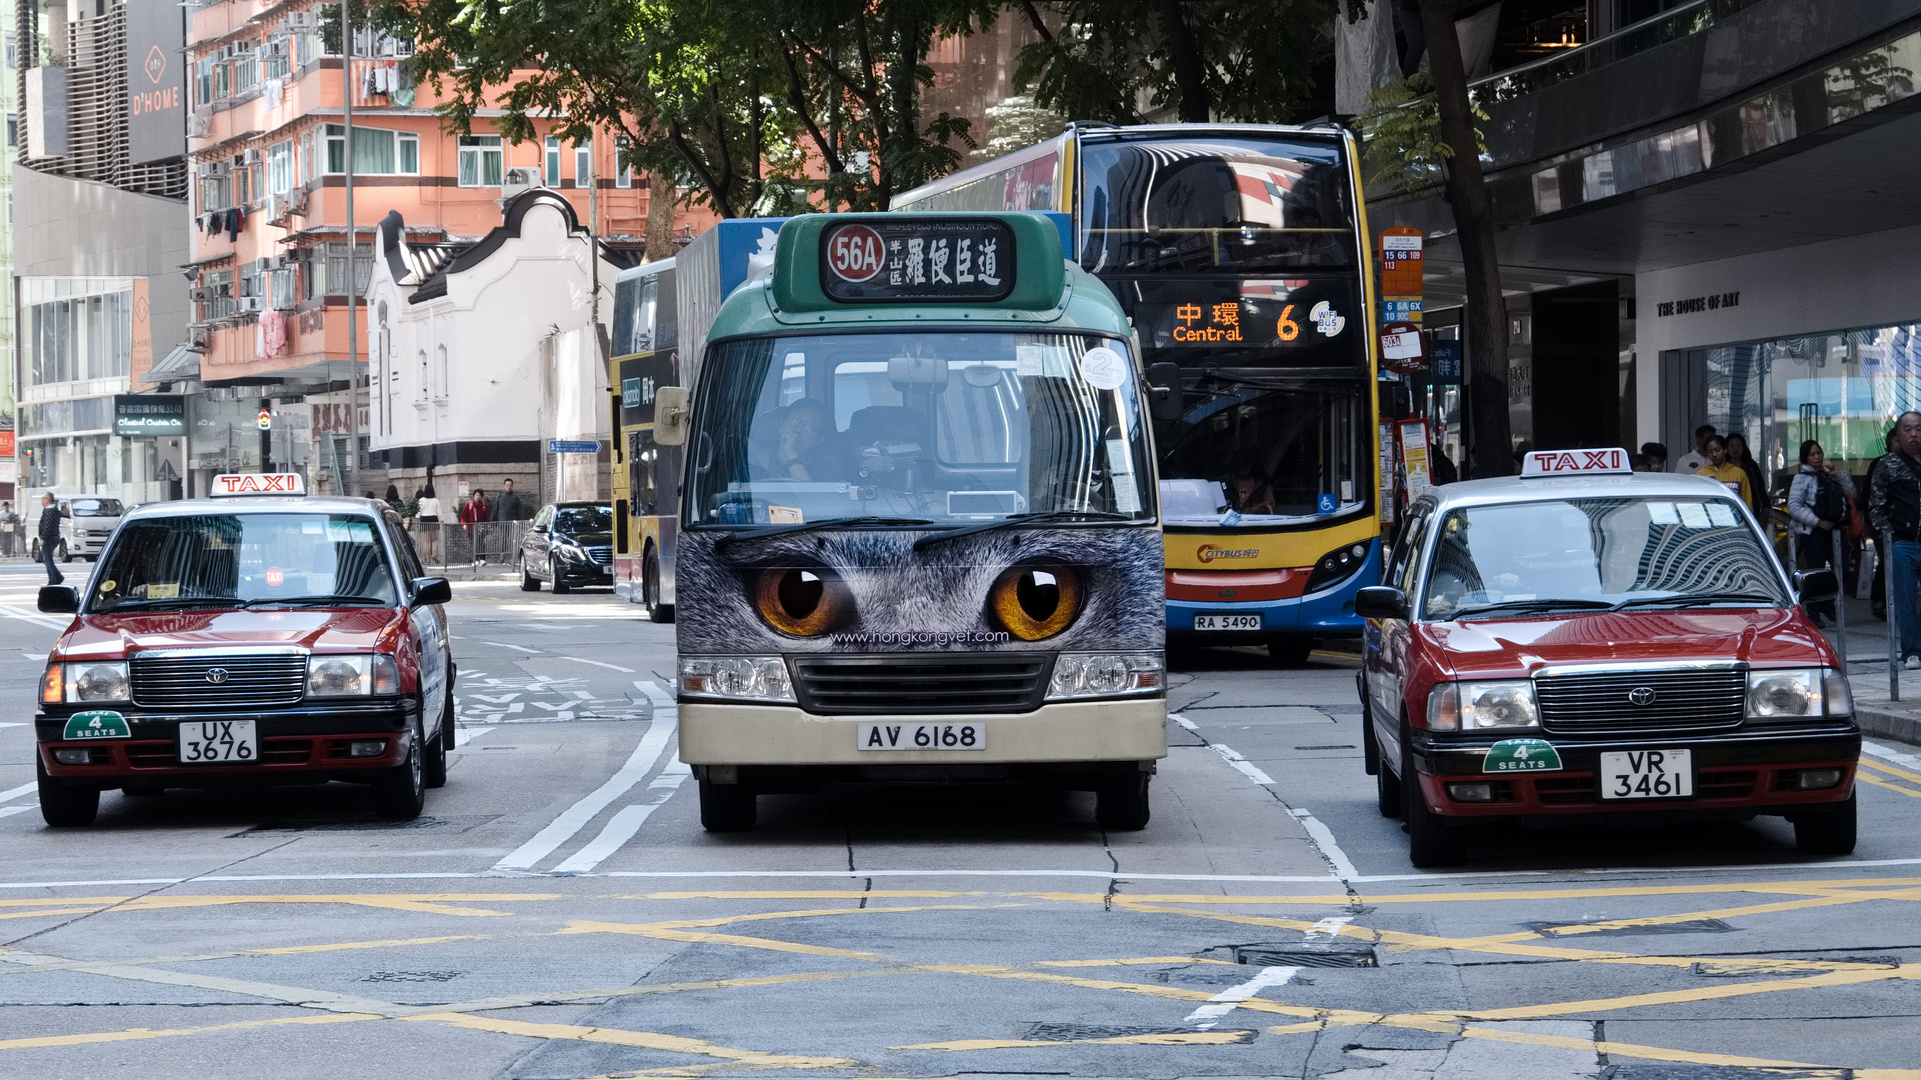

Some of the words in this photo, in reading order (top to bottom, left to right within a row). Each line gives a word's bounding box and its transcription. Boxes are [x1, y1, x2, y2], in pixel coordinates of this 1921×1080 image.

[133, 86, 179, 116] D'HOME
[836, 236, 877, 271] 56A
[905, 237, 1001, 286] 羅便臣道
[1385, 251, 1395, 260] 15
[1397, 251, 1407, 260] 66
[1409, 251, 1421, 260] 109
[889, 240, 902, 286] 半山區
[1384, 261, 1395, 270] 113
[1387, 302, 1393, 311] 6
[1397, 302, 1408, 311] 6A
[1410, 302, 1421, 311] 6X
[1656, 301, 1674, 317] THE
[1676, 296, 1705, 314] HOUSE
[1707, 294, 1720, 310] OF
[1721, 291, 1740, 308] ART
[1176, 302, 1240, 327] 中環
[1276, 304, 1299, 342] 6
[1317, 310, 1338, 319] WIFI
[1318, 319, 1337, 327] BUS
[1385, 312, 1395, 321] 10
[1173, 326, 1243, 342] Central
[1534, 450, 1620, 472] TAXI
[221, 475, 295, 492] TAXI
[1205, 549, 1243, 558] CITYBUS
[266, 570, 283, 582] TAXI
[1197, 617, 1215, 628] RA
[1221, 616, 1257, 628] 5490
[829, 629, 1010, 646] www.hongkongvet.com
[88, 716, 102, 729] 4
[202, 721, 234, 741] UX
[76, 728, 116, 737] SEATS
[867, 725, 901, 747] AV
[914, 725, 976, 747] 6168
[186, 740, 252, 761] 3676
[1513, 744, 1529, 760] 4
[1498, 760, 1546, 770] SEATS
[1626, 751, 1666, 774] VR
[1614, 772, 1681, 797] 3461
